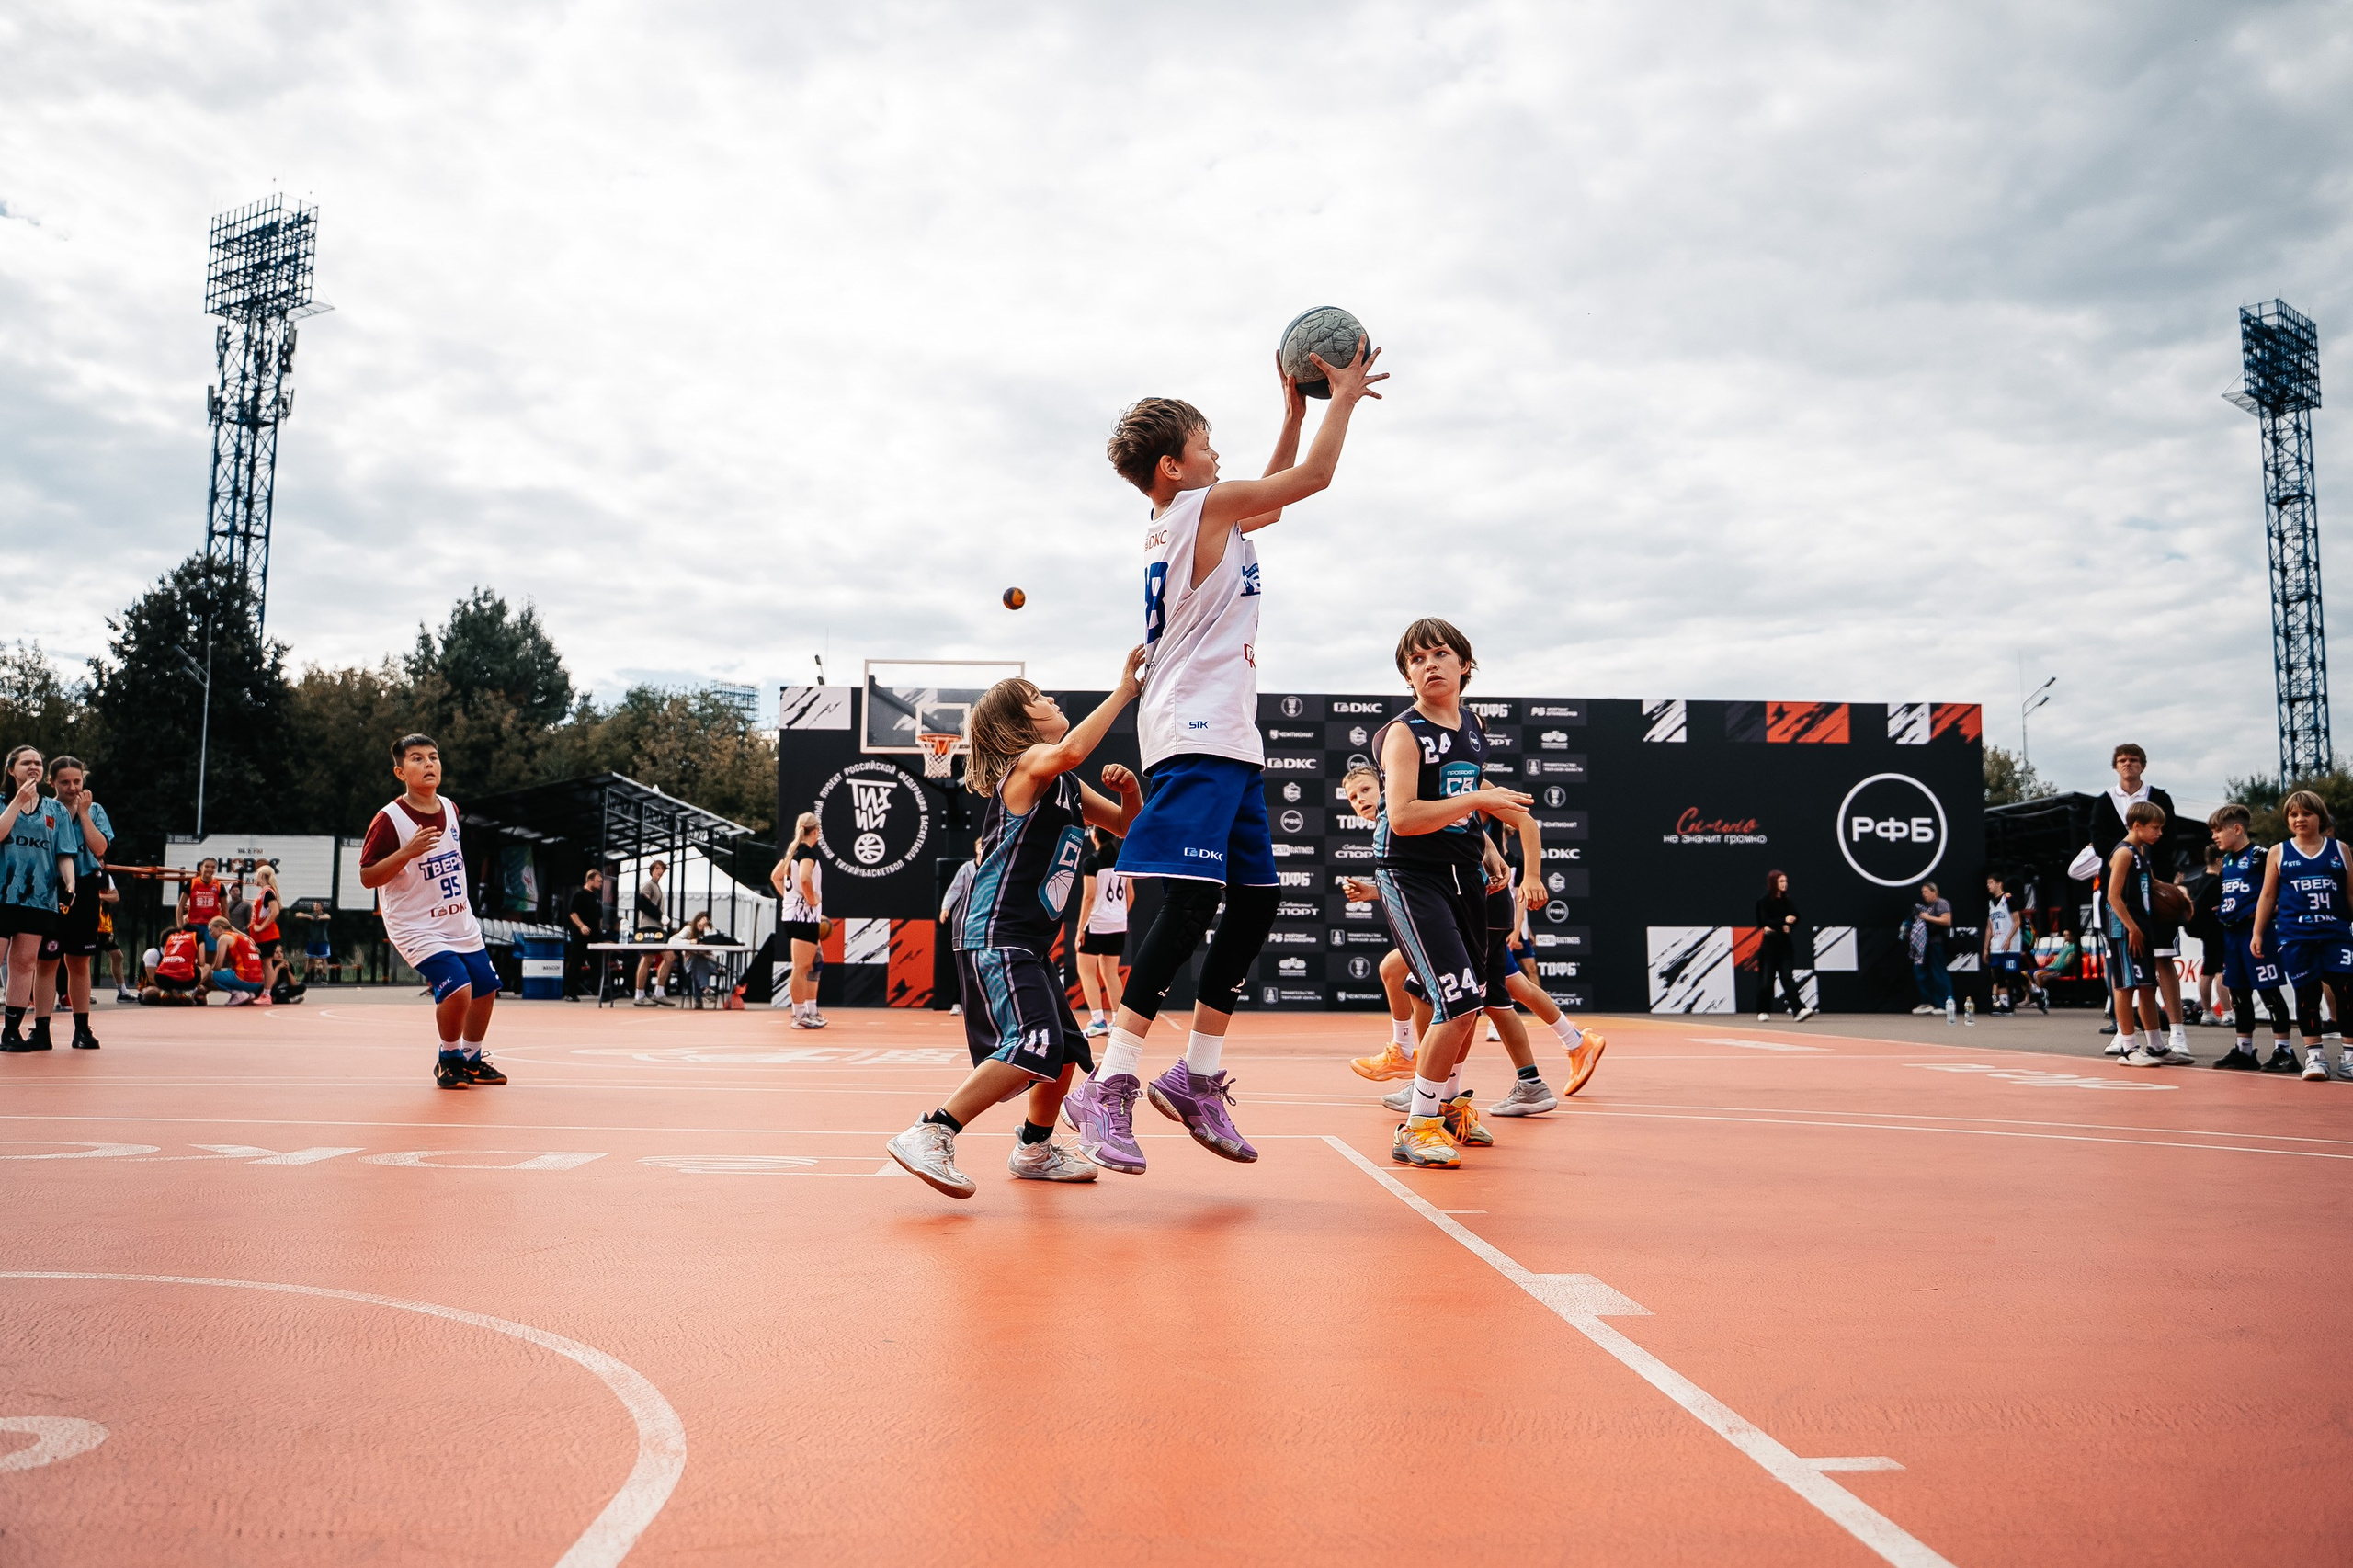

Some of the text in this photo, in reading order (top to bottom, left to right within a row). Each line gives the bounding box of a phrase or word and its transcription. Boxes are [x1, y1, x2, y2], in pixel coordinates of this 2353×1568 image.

[1188, 721, 1209, 730] STK
[1418, 733, 1452, 764] 24
[844, 760, 896, 776] РОССИЙСКОЙ
[819, 772, 843, 799] ПРОЕКТ
[897, 771, 928, 812] ФЕДЕРАЦИИ
[904, 815, 929, 861] БАСКЕТБОЛА
[1851, 816, 1935, 843] РФБ
[1663, 835, 1768, 846] не значит громко
[1548, 848, 1581, 859] DKC
[420, 856, 463, 880] ТВЕРЬ
[440, 875, 462, 899] 95
[1106, 875, 1125, 903] 66
[2222, 880, 2251, 894] ВЕРЬ
[2290, 879, 2337, 892] ТВЕРЬ
[2307, 892, 2331, 910] 34
[168, 940, 184, 955] 7
[2339, 949, 2353, 966] 3
[1537, 961, 1577, 976] ТОФБ
[2133, 964, 2143, 979] 3
[2173, 958, 2204, 983] DK
[2256, 964, 2279, 983] 20
[1438, 967, 1480, 1003] 24
[1022, 1028, 1051, 1058] 11
